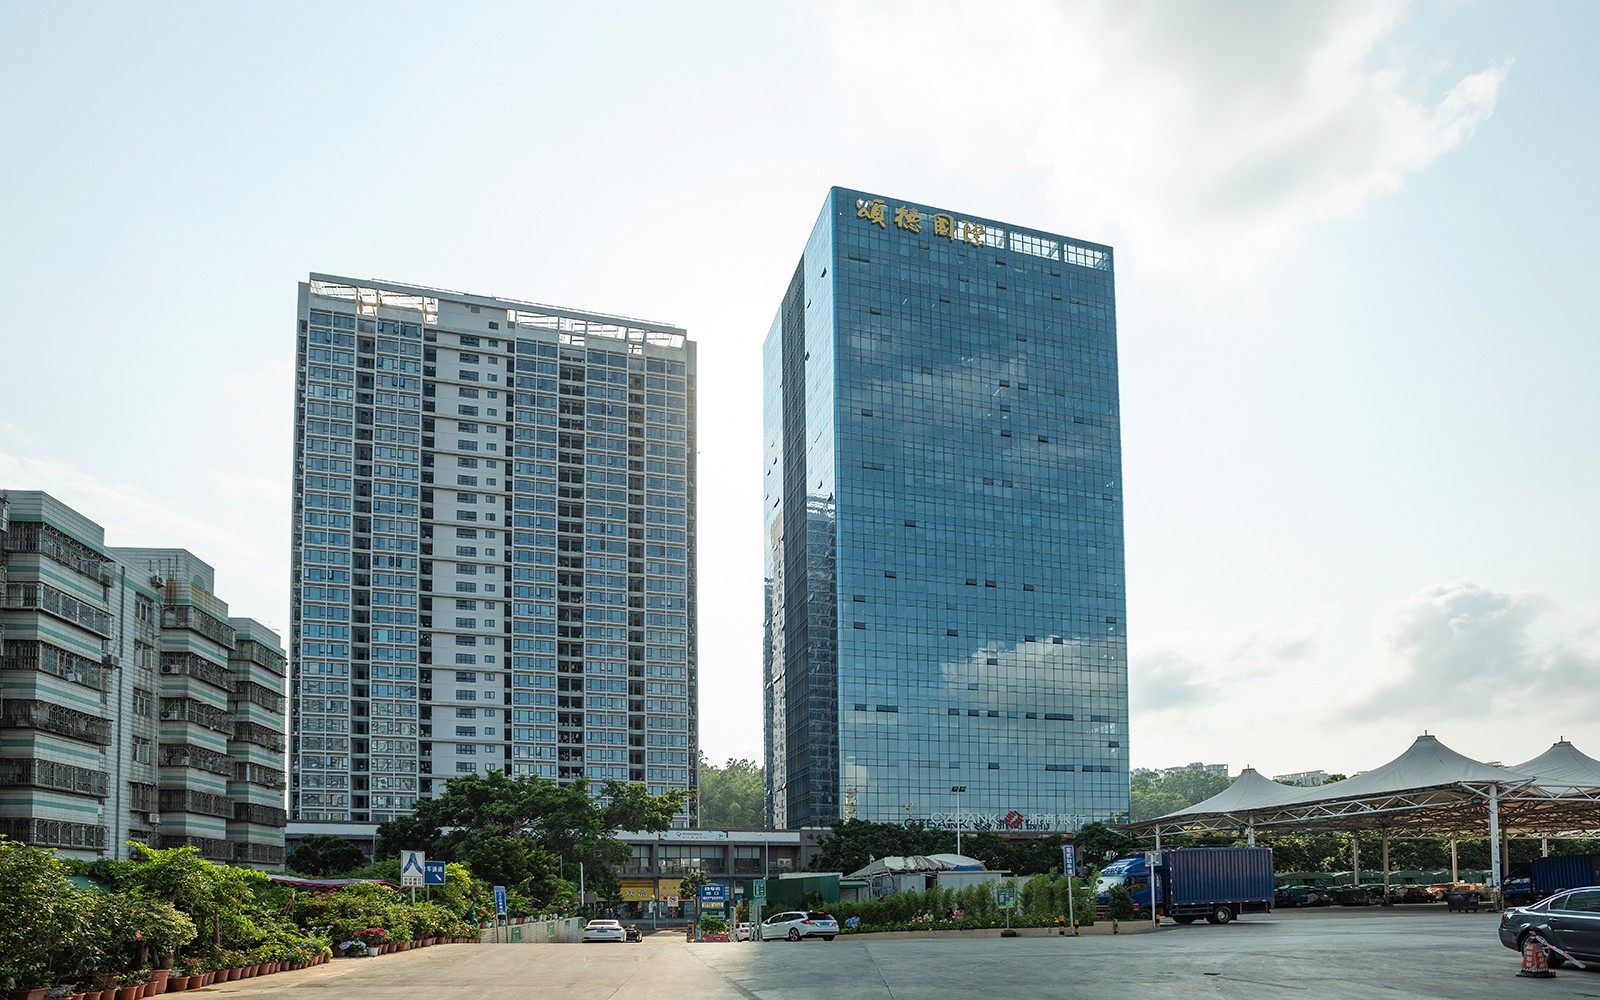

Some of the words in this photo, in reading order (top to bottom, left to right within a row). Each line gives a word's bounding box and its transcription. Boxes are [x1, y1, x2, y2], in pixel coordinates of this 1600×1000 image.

[930, 812, 999, 825] CZBANK
[1028, 813, 1087, 826] 浙商银行
